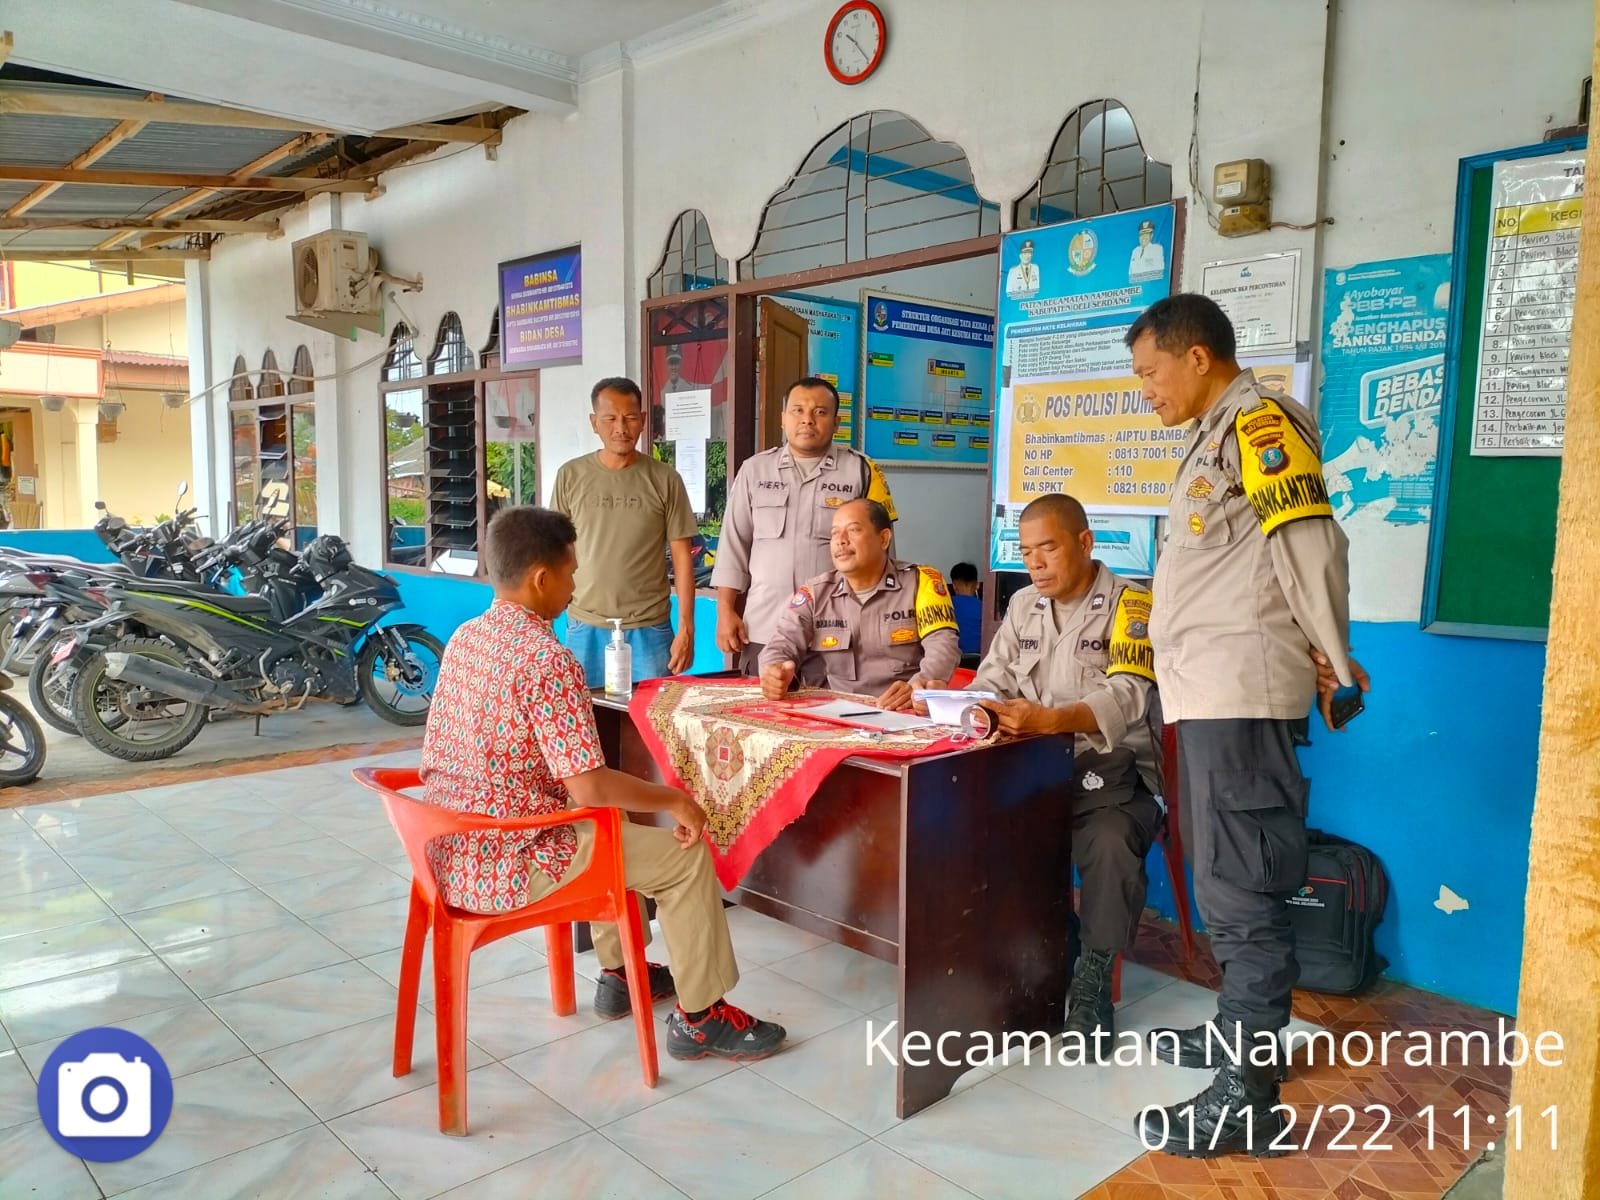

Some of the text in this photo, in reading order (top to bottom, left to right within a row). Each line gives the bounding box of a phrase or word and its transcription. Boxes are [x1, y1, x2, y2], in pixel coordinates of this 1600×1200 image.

[1564, 167, 1585, 178] TA
[1497, 217, 1516, 229] NO
[1499, 254, 1509, 263] 2.
[1498, 268, 1508, 278] 3.
[523, 269, 558, 288] BABINSA
[1497, 282, 1507, 292] 4.
[1043, 294, 1089, 307] KECAMATAN
[1091, 286, 1142, 299] NAMORAMBE
[506, 293, 580, 318] BHABINKAMTIBMAS
[1495, 297, 1505, 307] 5.
[1029, 305, 1071, 317] KABUPATEN
[1494, 311, 1504, 321] 6.
[1347, 317, 1446, 336] PENGHAPUS
[520, 324, 565, 344] BIDAN DESA
[1333, 330, 1446, 349] SANKSI DENDA
[1492, 339, 1502, 349] 8.
[1368, 345, 1393, 354] PAJAK
[1490, 354, 1500, 363] 9.
[1486, 367, 1503, 377] 10.
[1485, 381, 1501, 391] 11.
[1045, 396, 1071, 418] POS
[1075, 392, 1118, 417] POLISI
[1484, 395, 1500, 405] 12.
[1482, 409, 1499, 419] 13.
[1481, 424, 1498, 433] 14.
[1025, 432, 1106, 445] Bhabinkamtibmas
[1116, 430, 1147, 442] AIPTU
[1480, 438, 1497, 446] 15.
[1024, 450, 1038, 460] NO
[1040, 450, 1053, 460] HP
[1114, 448, 1139, 459] 0813
[1143, 448, 1167, 459] 7001
[1171, 447, 1185, 458] 50
[1023, 466, 1040, 476] Call
[1042, 465, 1074, 476] Center
[1114, 466, 1133, 476] 110
[758, 480, 787, 490] HERY
[820, 482, 853, 493] POLRI
[1022, 481, 1036, 492] WA
[1039, 481, 1064, 492] SPKT
[1113, 482, 1138, 494] 0821
[1141, 483, 1166, 494] 6180
